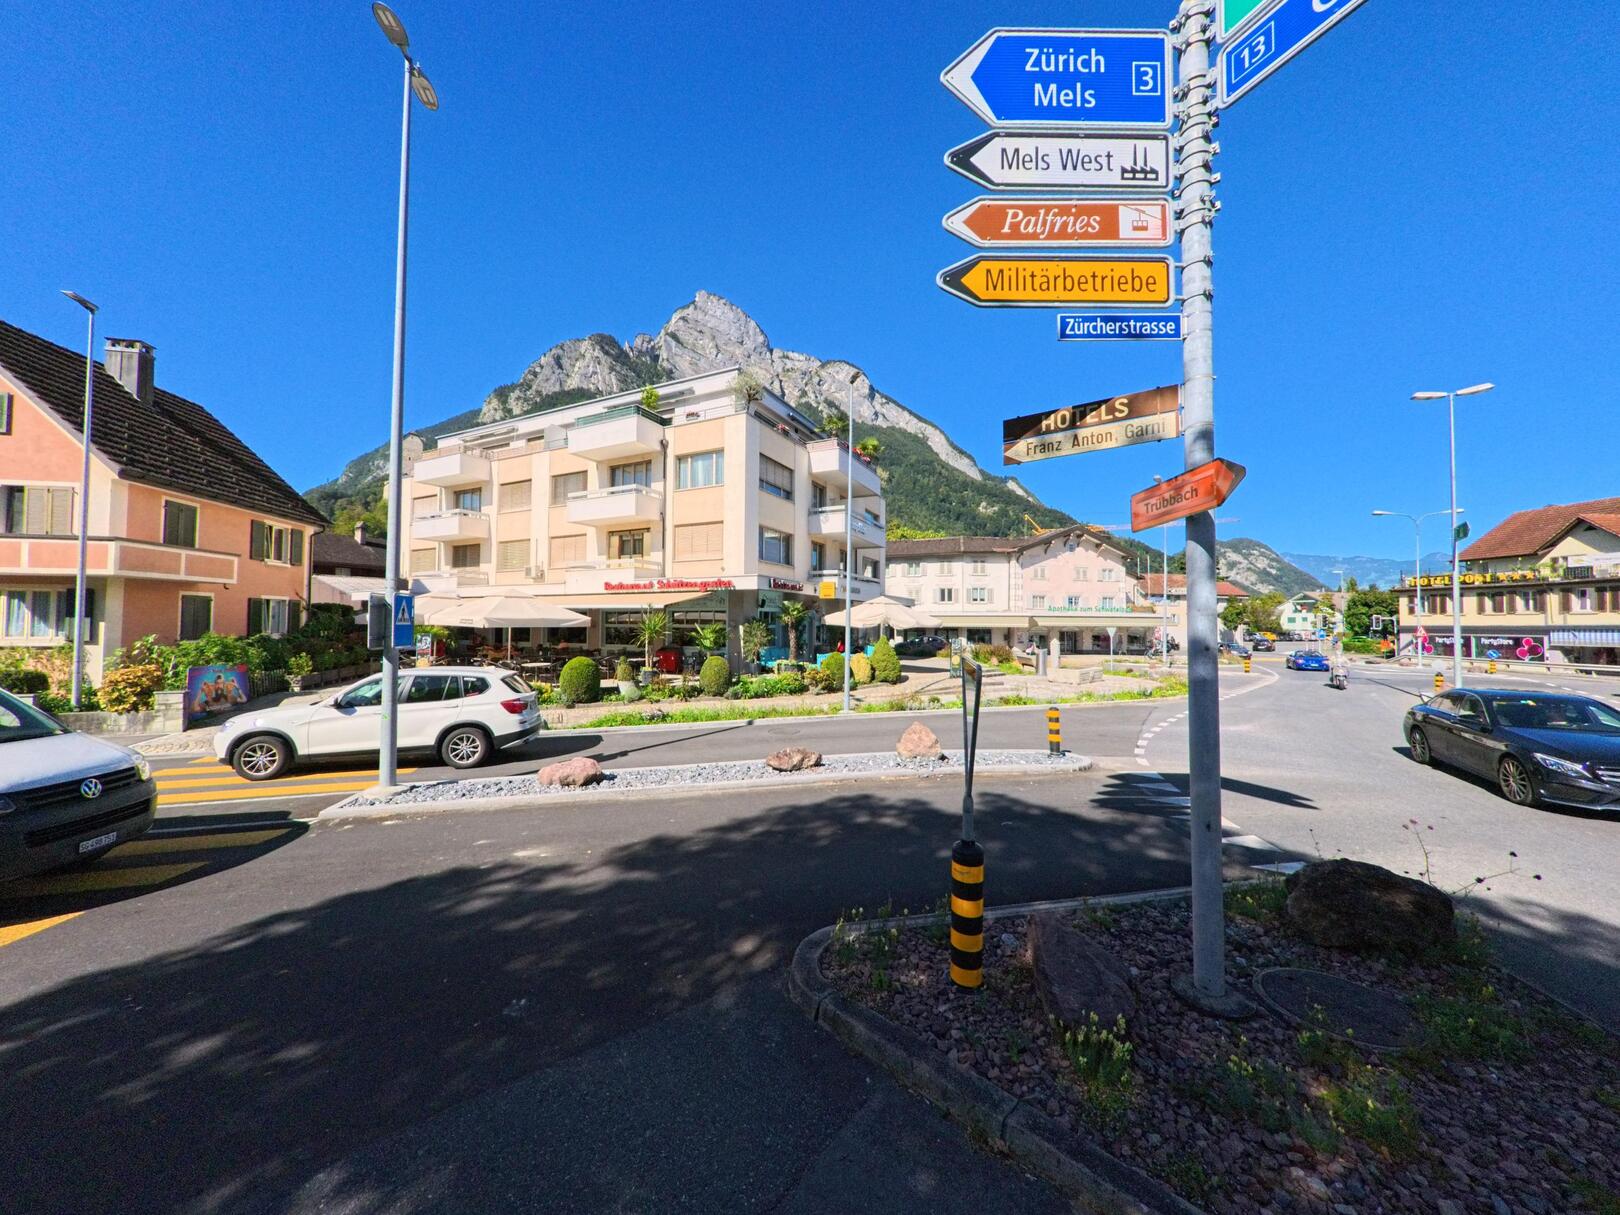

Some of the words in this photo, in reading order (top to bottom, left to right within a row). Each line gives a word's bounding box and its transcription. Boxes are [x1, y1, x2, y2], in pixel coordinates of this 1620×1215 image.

[1025, 47, 1106, 73] Zürich
[1239, 35, 1266, 69] 13
[1139, 67, 1154, 90] 3
[1033, 83, 1096, 108] Mels
[1000, 147, 1051, 171] Mels
[1059, 147, 1114, 172] West
[1001, 208, 1101, 238] Palfries
[985, 267, 1157, 293] Militärbetriebe
[1065, 317, 1176, 335] Zürcherstrasse
[1041, 398, 1129, 432] HOTELS
[1026, 441, 1062, 457] Franz
[1124, 418, 1167, 438] Garni
[1144, 486, 1199, 514] Trübbach
[1408, 575, 1452, 587] HOTEL
